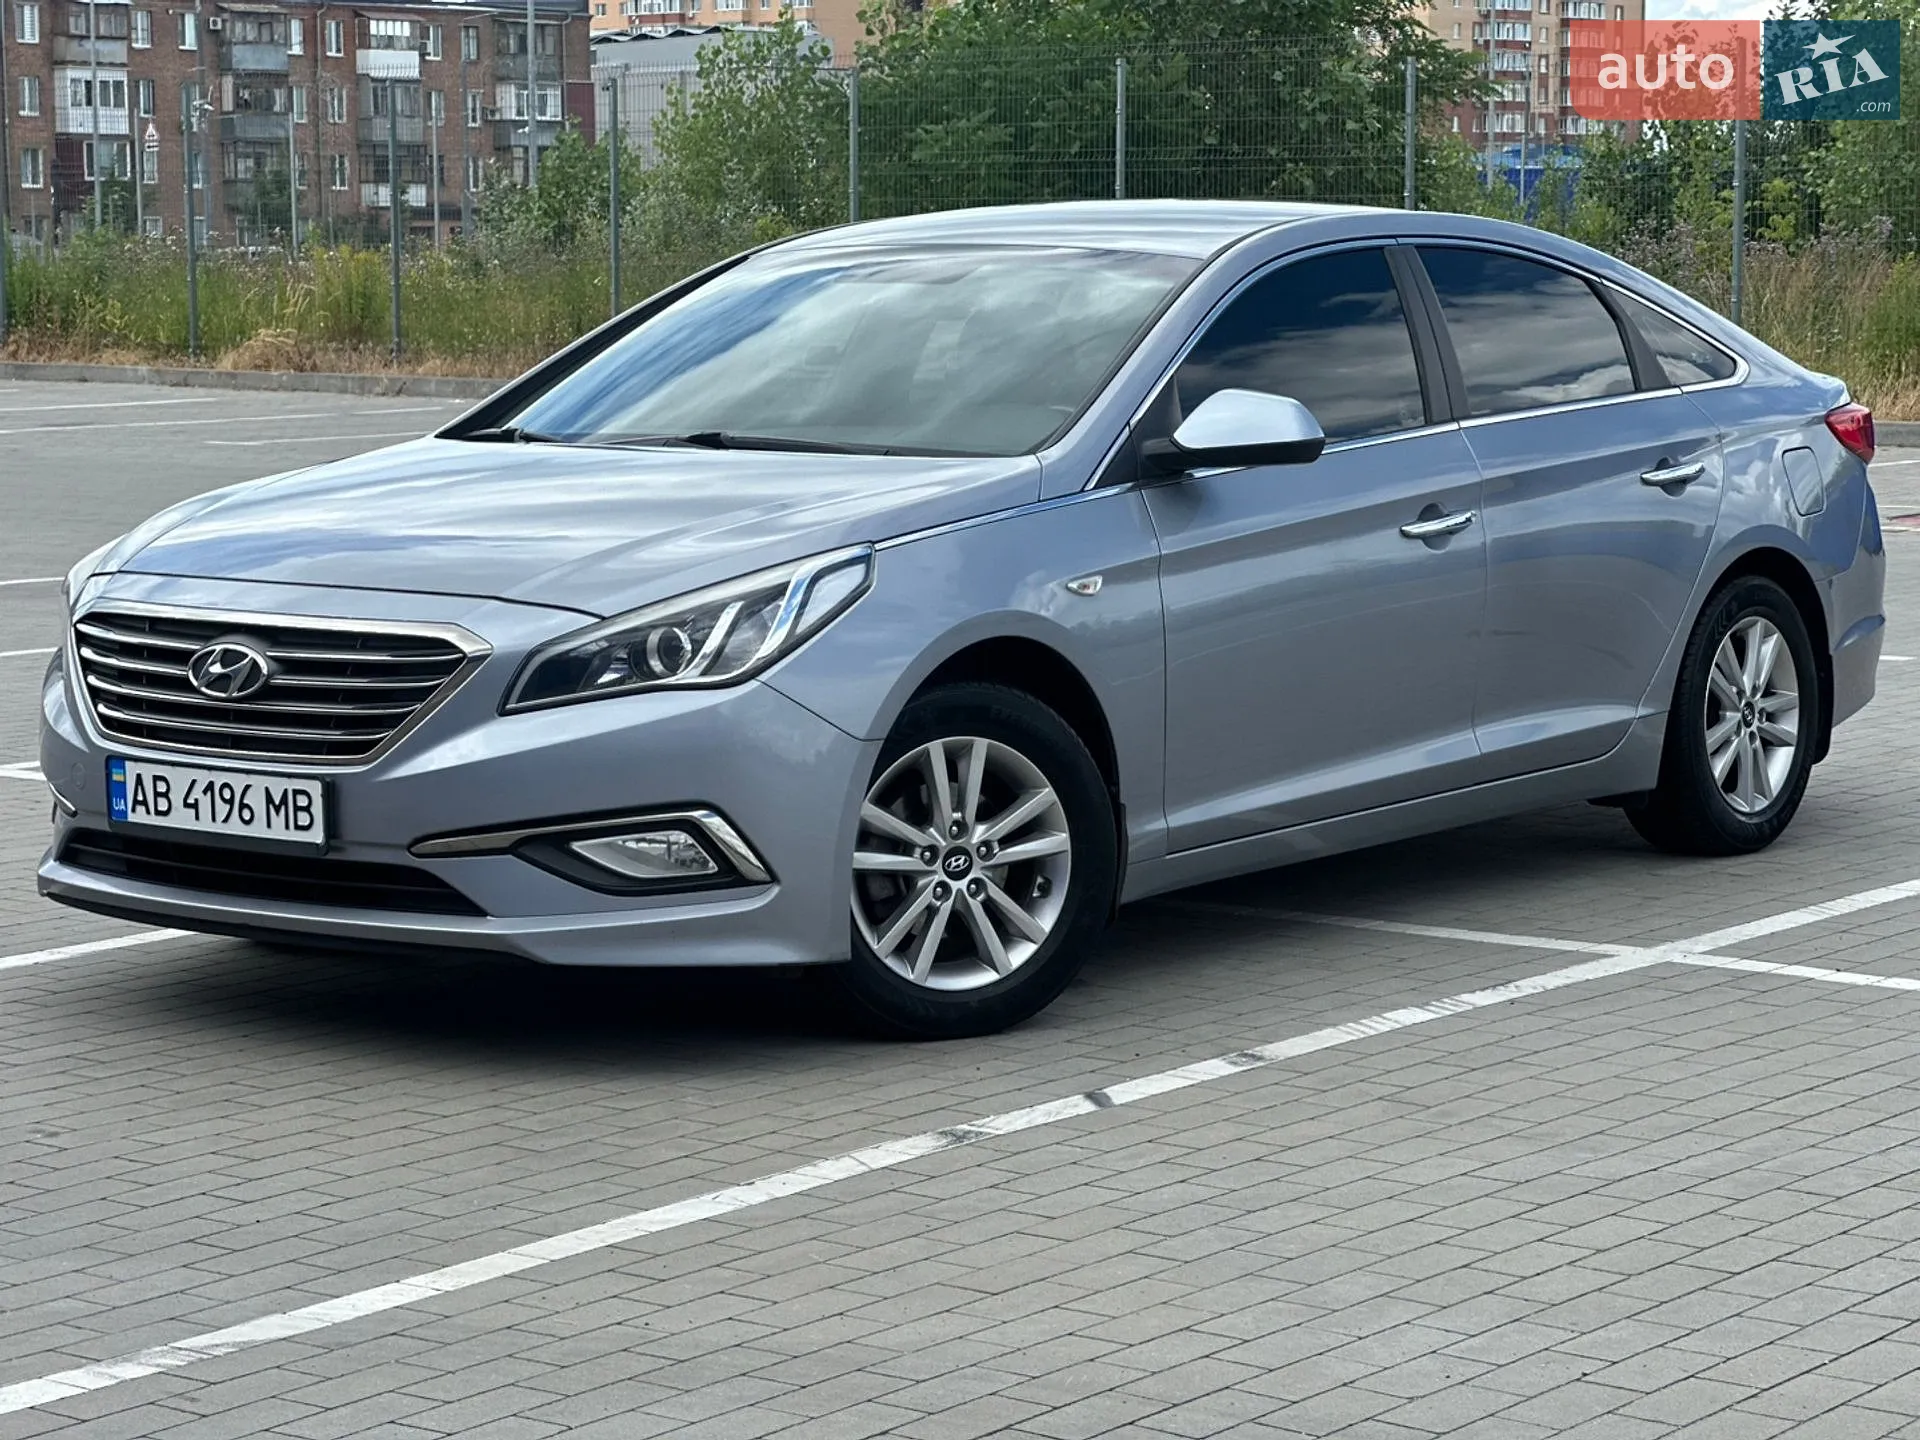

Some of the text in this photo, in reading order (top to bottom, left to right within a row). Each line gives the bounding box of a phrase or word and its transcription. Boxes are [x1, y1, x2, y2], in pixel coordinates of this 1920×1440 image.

[112, 798, 126, 811] UA
[131, 773, 315, 832] AB 4196 MB
